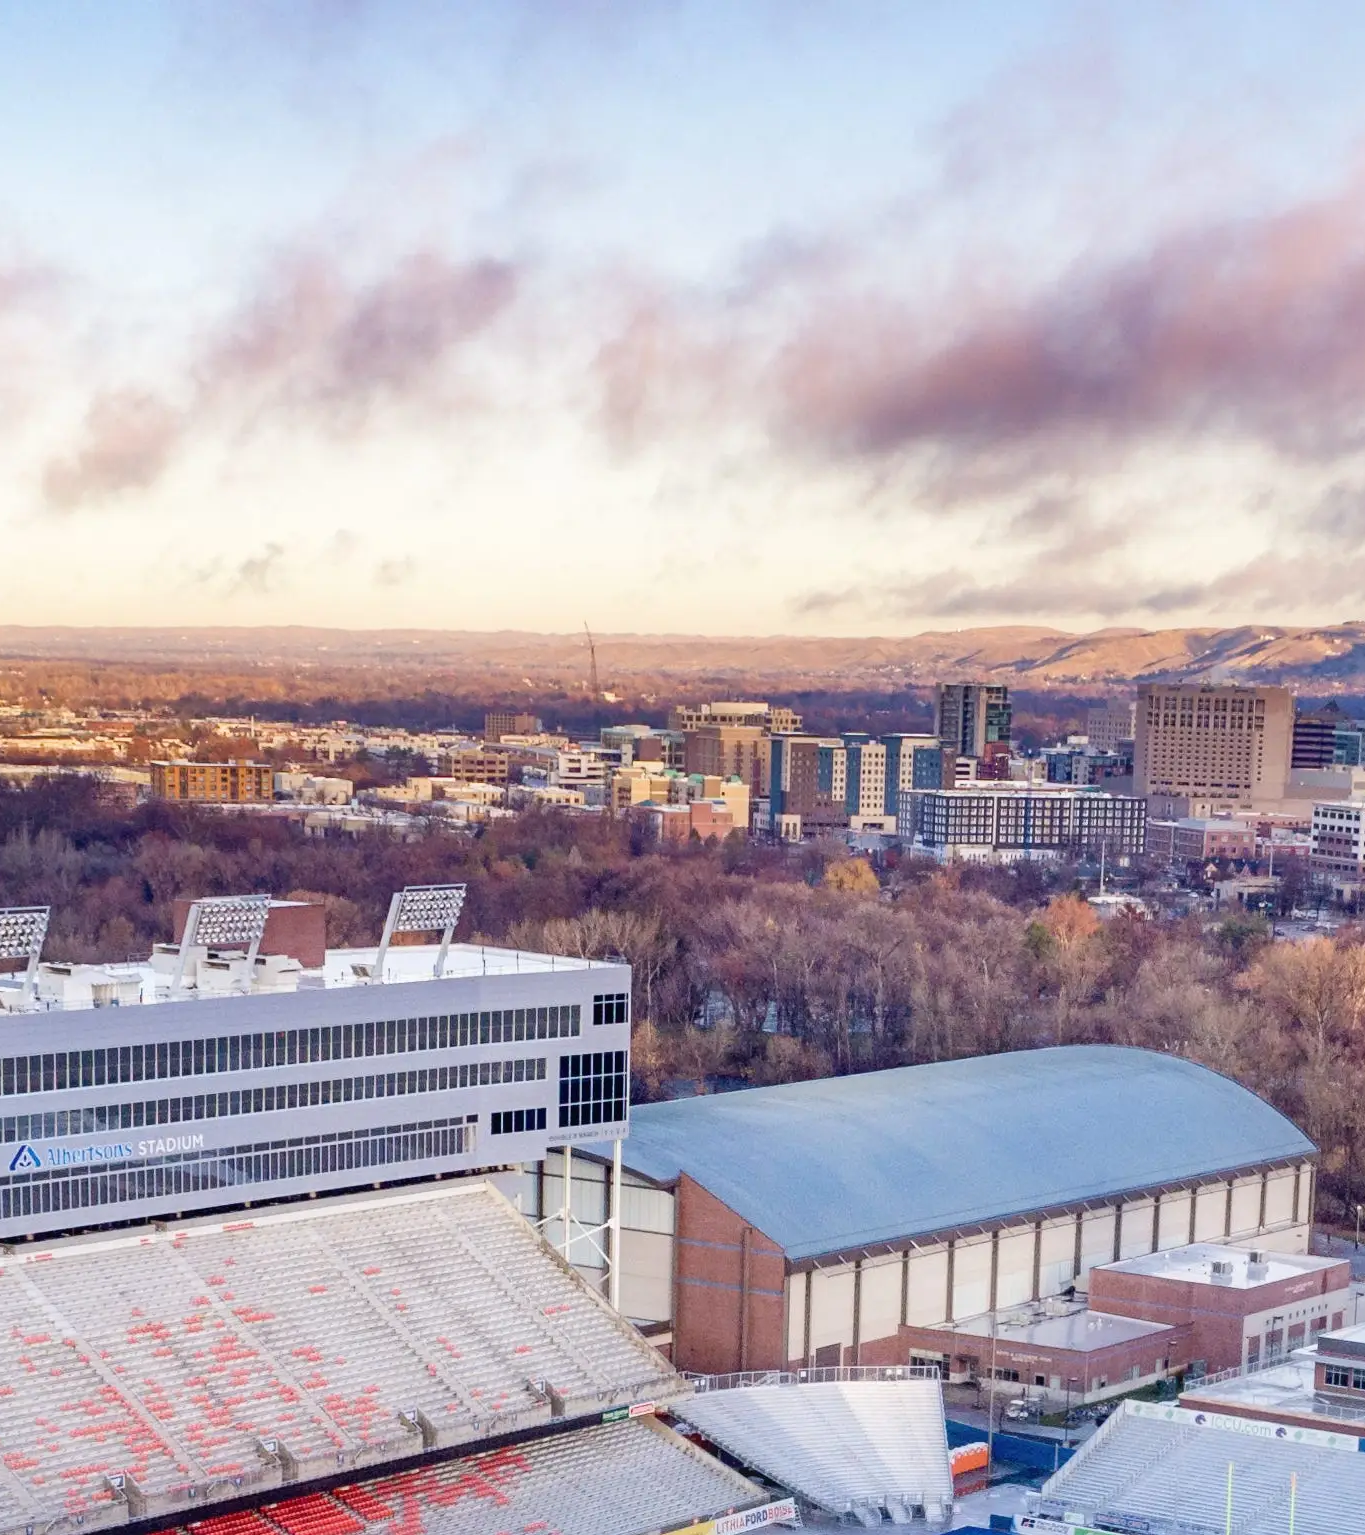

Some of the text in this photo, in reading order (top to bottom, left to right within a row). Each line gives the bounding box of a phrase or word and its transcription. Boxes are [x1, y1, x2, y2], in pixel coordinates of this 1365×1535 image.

[47, 1134, 204, 1167] Albertsons STADIUM
[1211, 1414, 1272, 1437] ICCU.com
